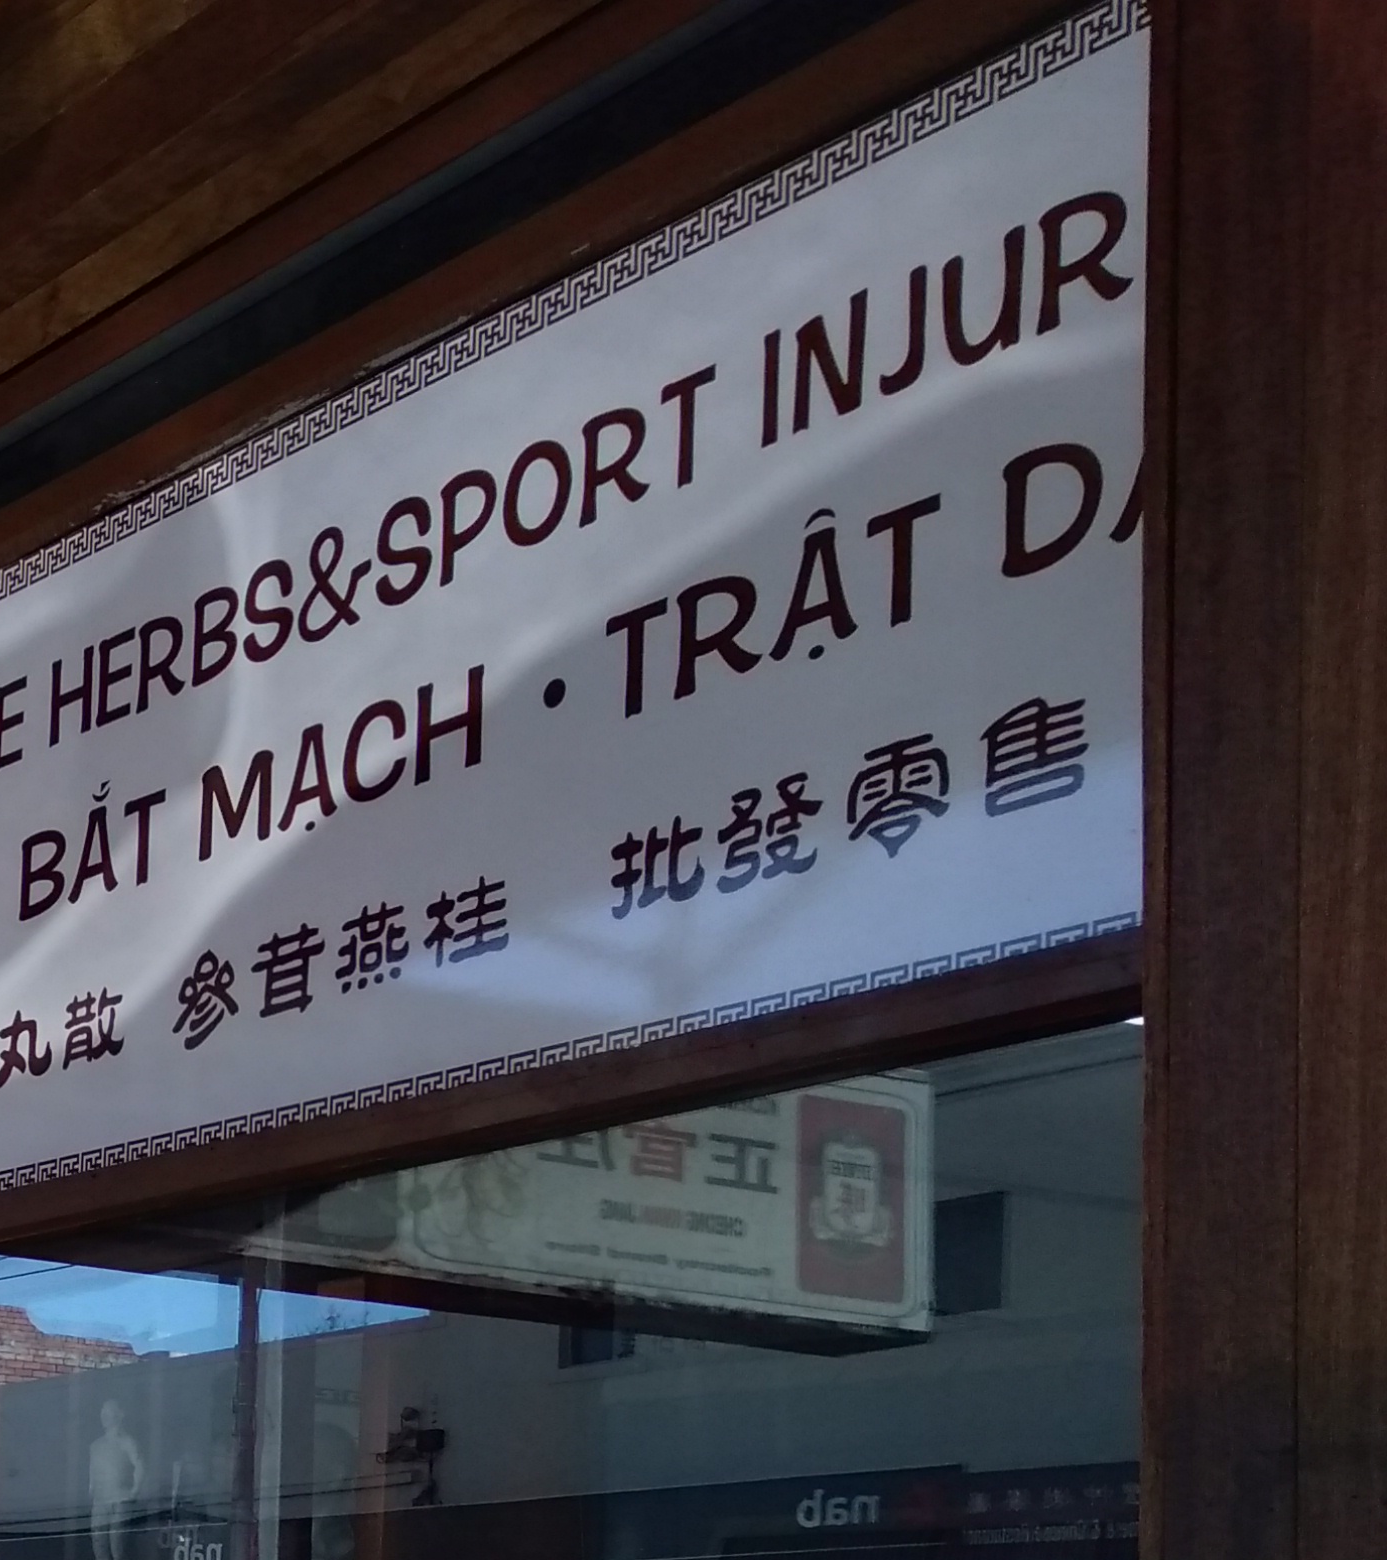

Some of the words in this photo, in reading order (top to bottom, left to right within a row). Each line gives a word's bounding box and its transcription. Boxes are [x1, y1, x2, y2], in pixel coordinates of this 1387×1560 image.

[761, 190, 1137, 449] INJUR
[17, 778, 167, 925] BẮT
[197, 664, 485, 862] MẠCH
[605, 492, 942, 719] TRẬT
[610, 695, 1091, 921] 批發零售
